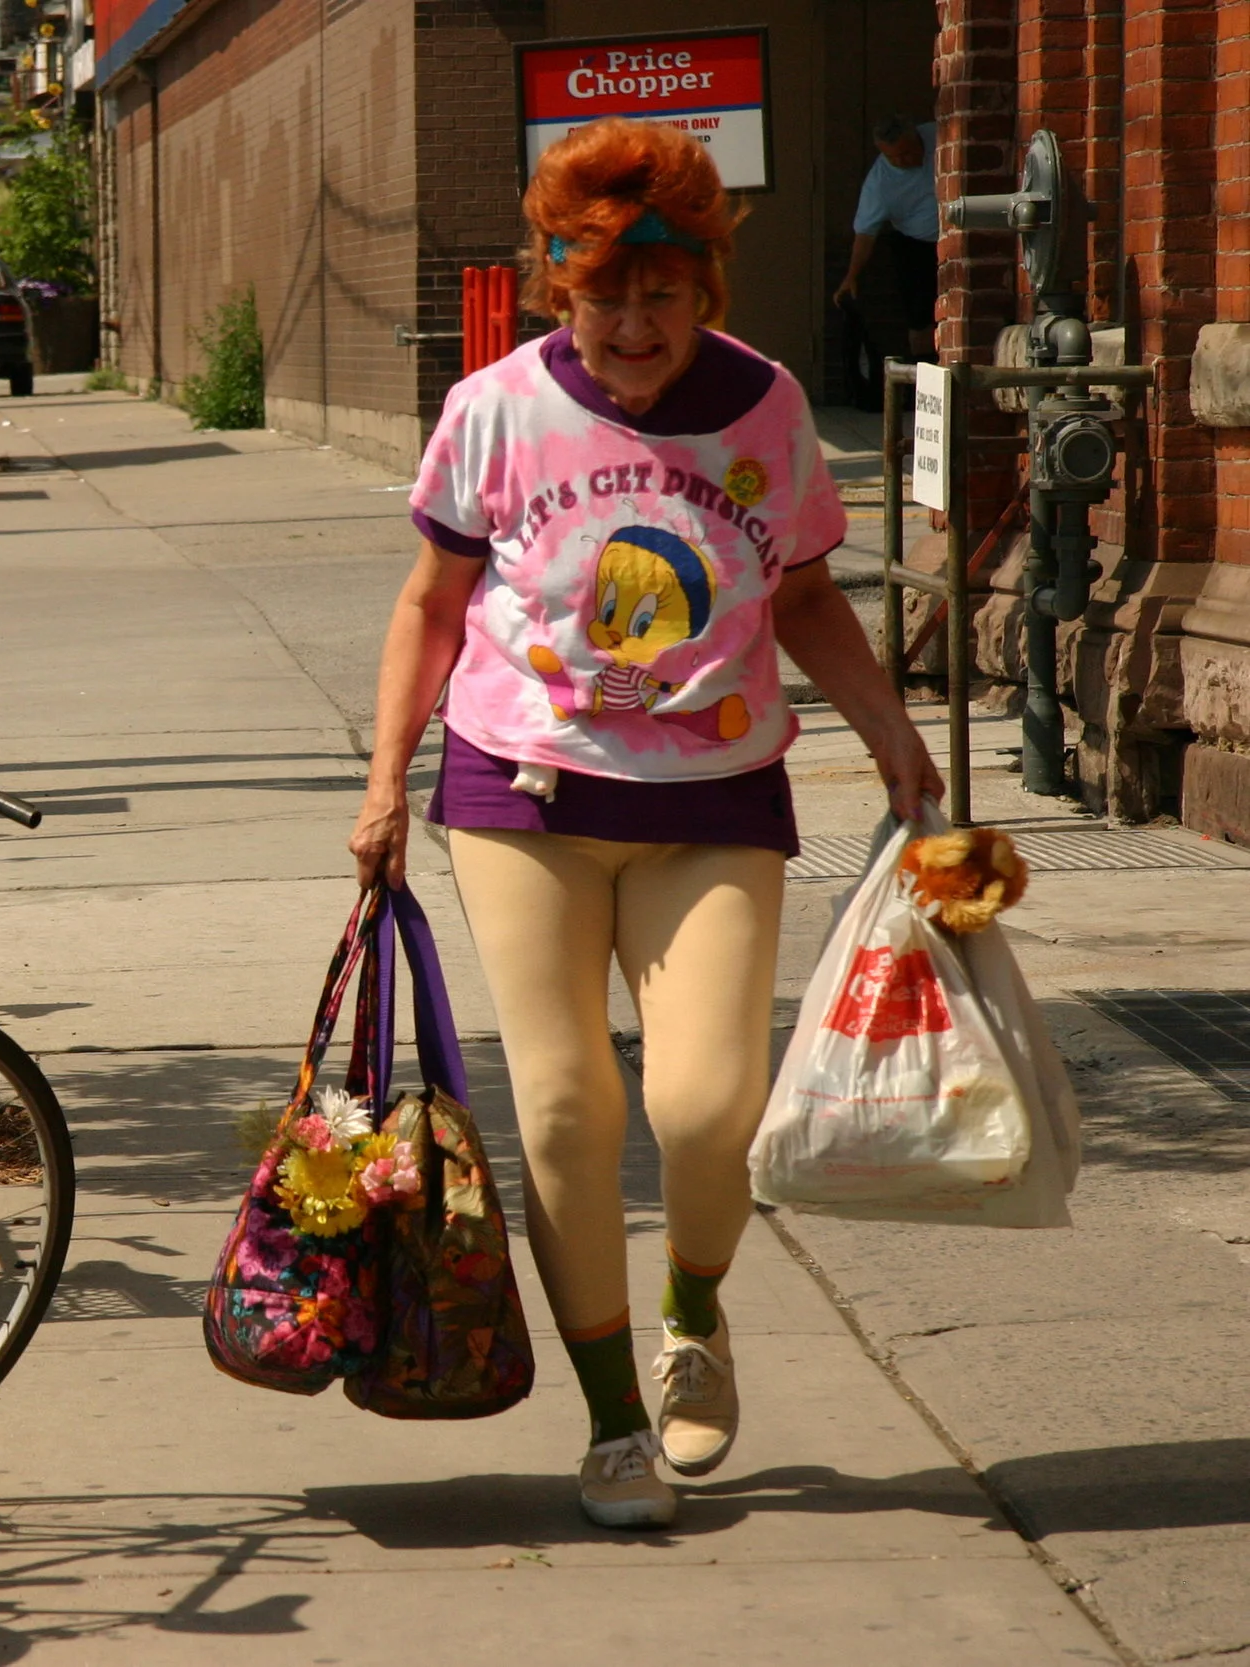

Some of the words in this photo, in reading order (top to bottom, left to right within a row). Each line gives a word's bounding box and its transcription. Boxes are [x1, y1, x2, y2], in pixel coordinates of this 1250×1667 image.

[607, 48, 692, 74] Price
[567, 67, 715, 99] Chopper
[692, 117, 720, 130] ONLY
[589, 461, 654, 496] GET
[661, 467, 781, 580] PHYSICAL
